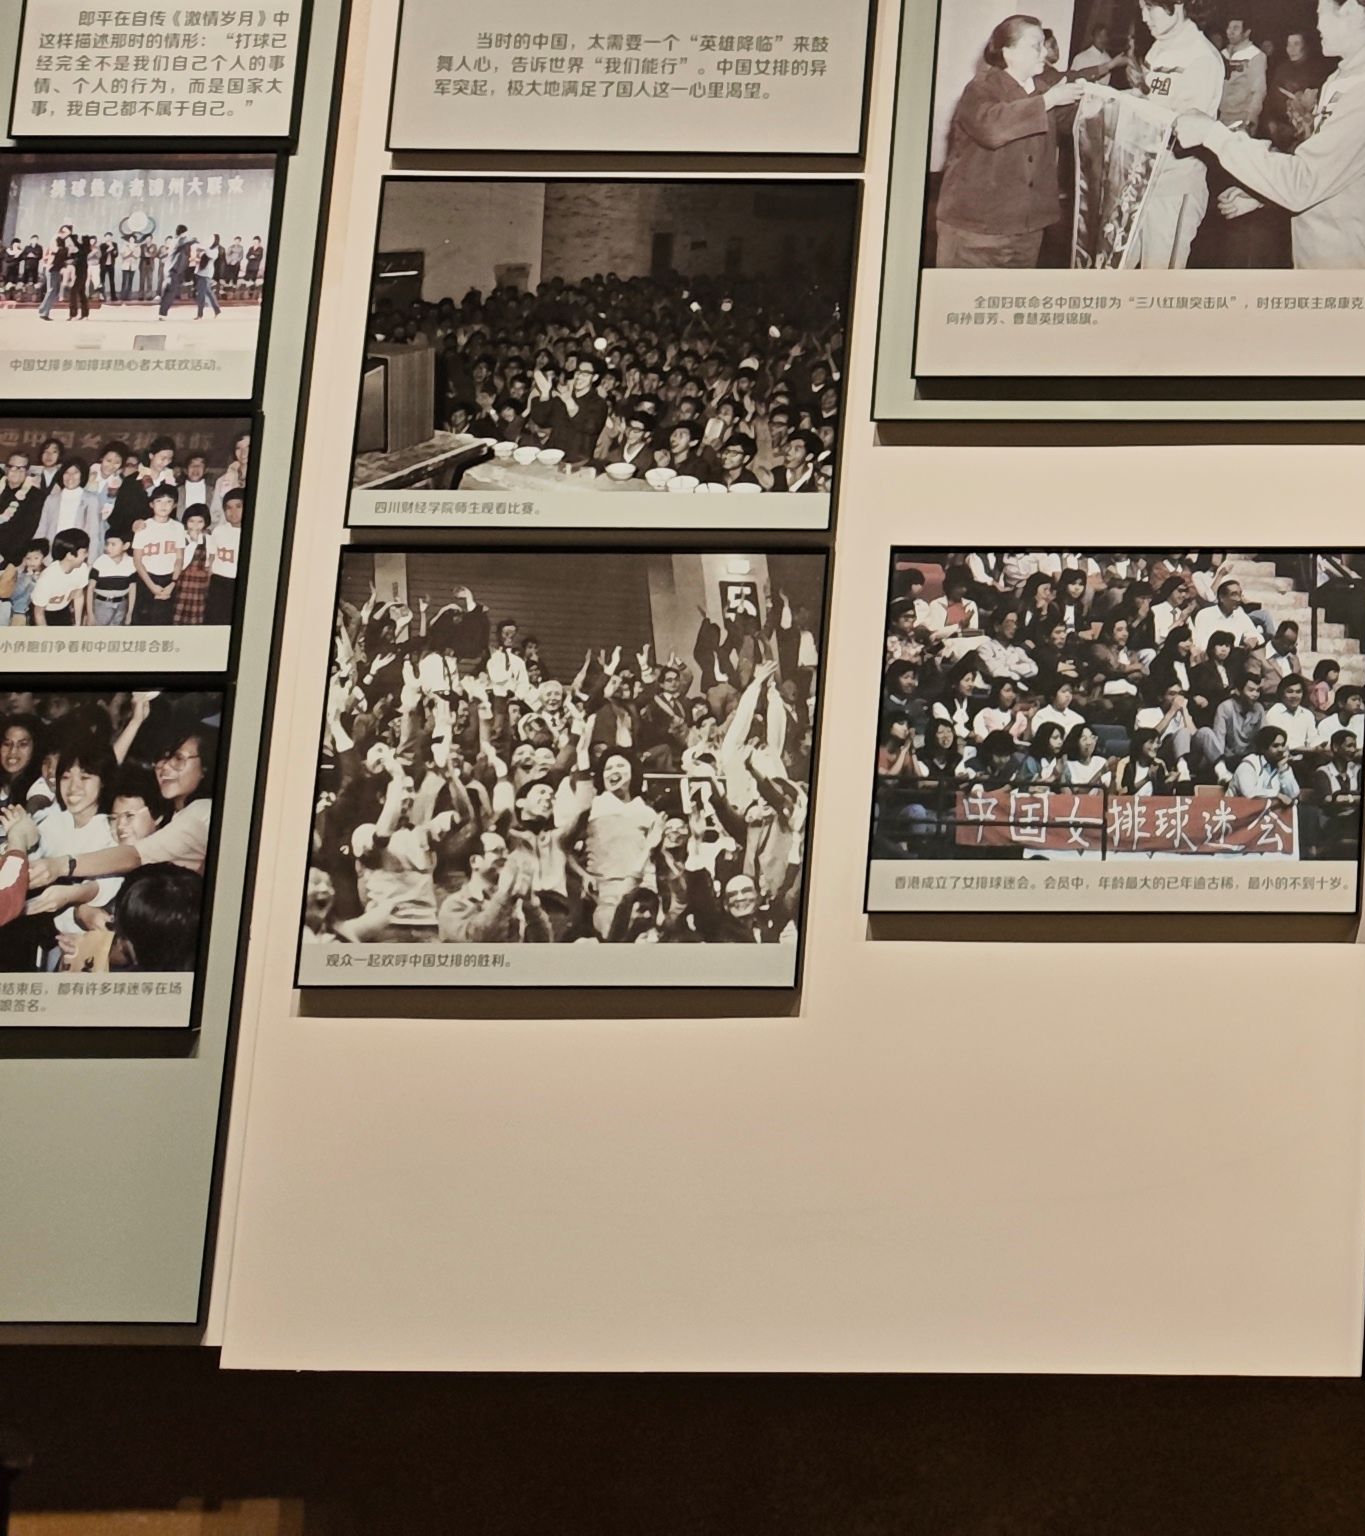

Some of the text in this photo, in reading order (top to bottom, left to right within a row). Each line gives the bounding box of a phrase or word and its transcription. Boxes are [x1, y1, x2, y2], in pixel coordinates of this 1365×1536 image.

[78, 10, 289, 27] 郎平在自传《激情岁月》中
[35, 55, 285, 71] 经完全不是我们自己个人的事
[434, 79, 769, 99] 军突起，极大地满足了国人这一心里渴望。
[375, 501, 539, 515] 四川财经学院师生观看比赛。
[961, 787, 1294, 852] 中国女排球迷会
[326, 954, 510, 967] 观众一起欢呼中国女排的胜利。
[0, 982, 182, 995] 结束后，都有许多球迷等在场
